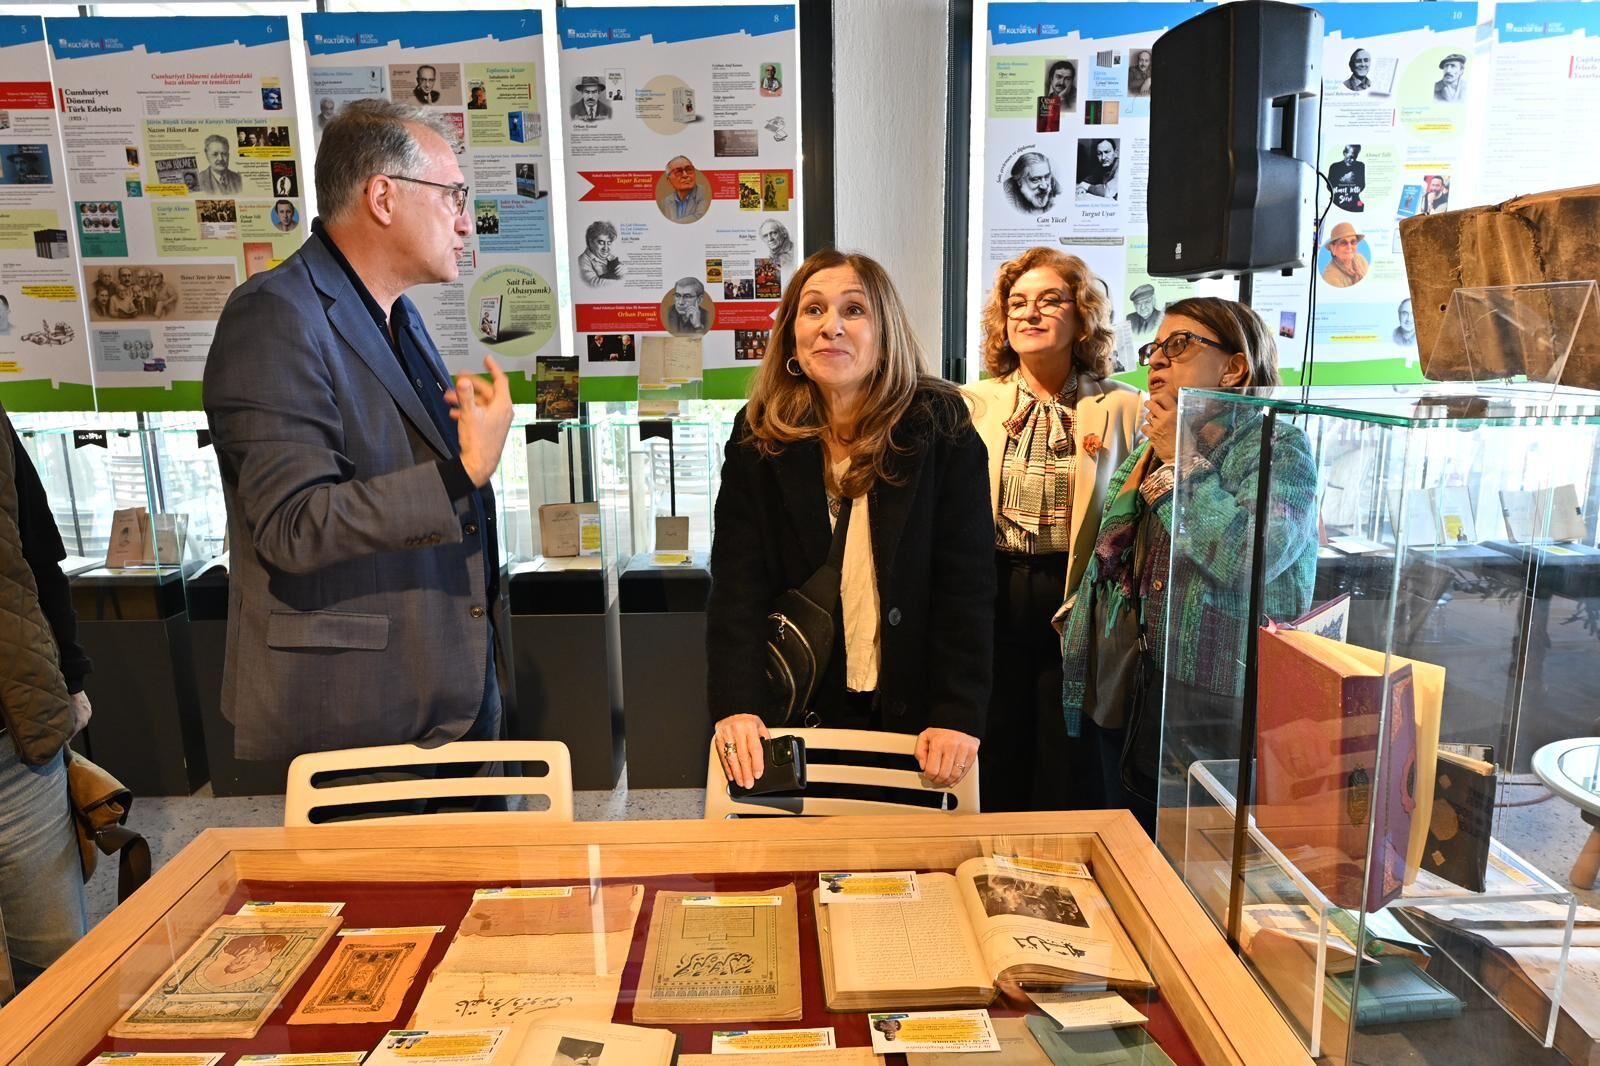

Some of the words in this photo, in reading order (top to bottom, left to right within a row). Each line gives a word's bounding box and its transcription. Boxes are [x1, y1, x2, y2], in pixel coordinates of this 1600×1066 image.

[773, 14, 780, 23] 8
[1452, 11, 1462, 19] 10
[520, 19, 526, 28] 7
[21, 25, 27, 34] 5
[267, 25, 273, 34] 6
[64, 88, 109, 97] Cumhuriyet
[68, 105, 86, 113] Türk
[87, 105, 122, 114] Edebiyatı
[1081, 210, 1101, 218] Turgut
[506, 278, 520, 286] Sait
[507, 286, 551, 296] (Abasıyanık)
